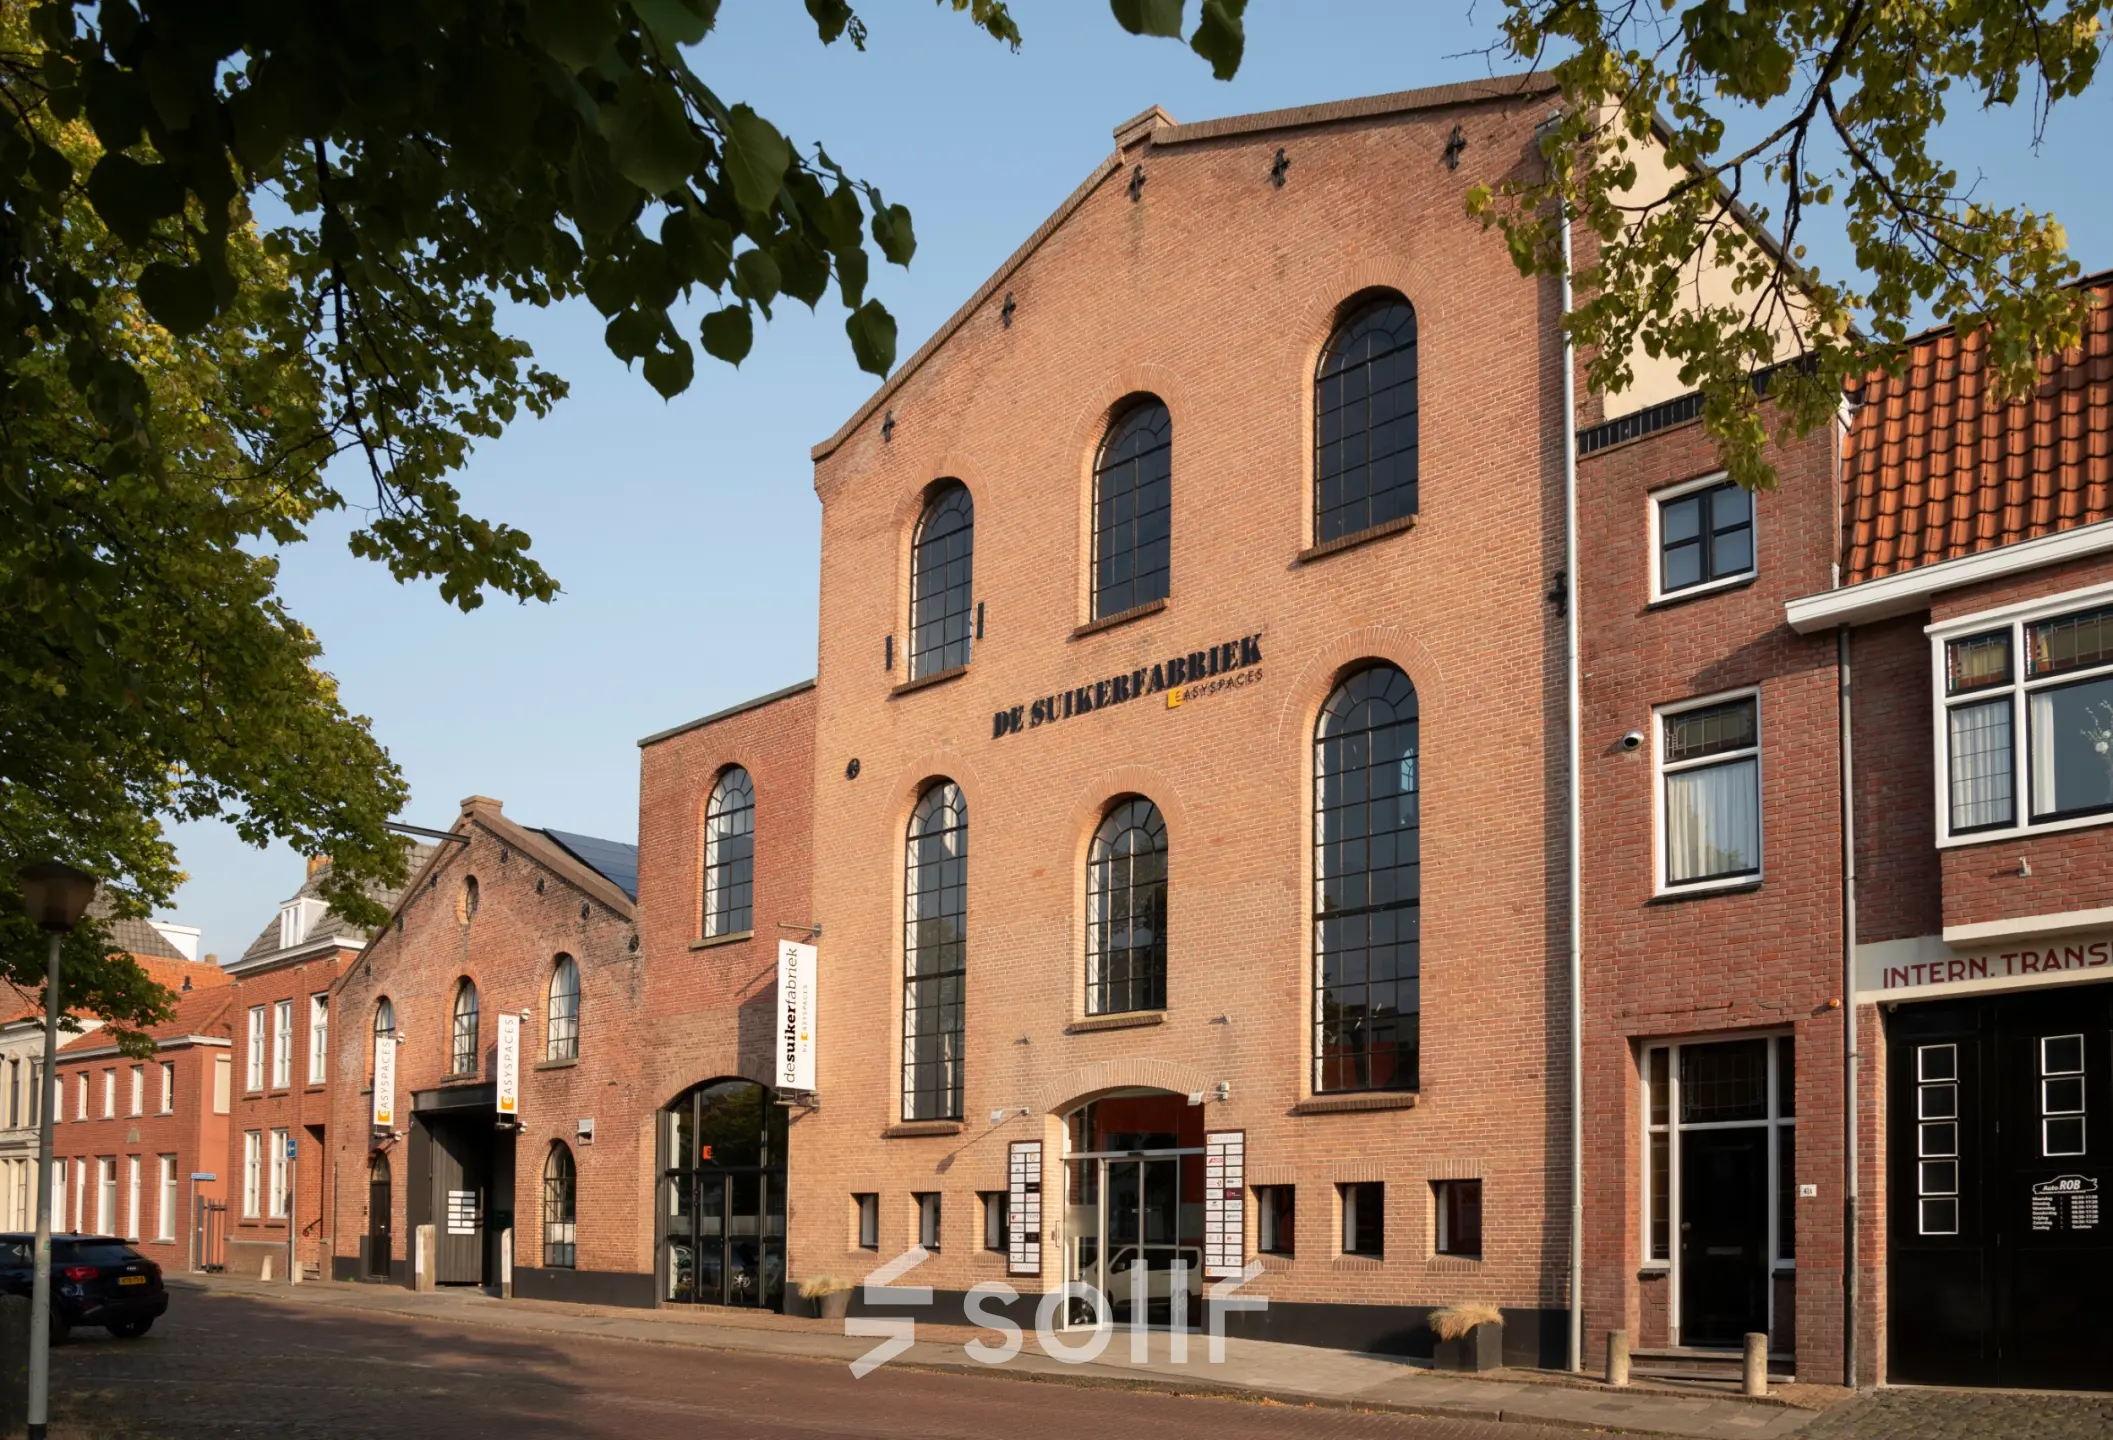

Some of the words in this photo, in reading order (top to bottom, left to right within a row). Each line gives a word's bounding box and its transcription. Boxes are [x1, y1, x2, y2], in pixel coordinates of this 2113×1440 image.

[992, 705, 1024, 739] DE
[1029, 633, 1263, 728] SUIKERFABRIEK
[1166, 668, 1264, 710] EASYSPACES
[1883, 957, 1995, 989] INTERN.
[2001, 942, 2113, 975] TRANS
[784, 948, 797, 1083] desuikerfabriek
[377, 1042, 391, 1122] EASYSPACES
[501, 1019, 514, 1110] EASYSPACES
[2059, 1179, 2081, 1190] ROB
